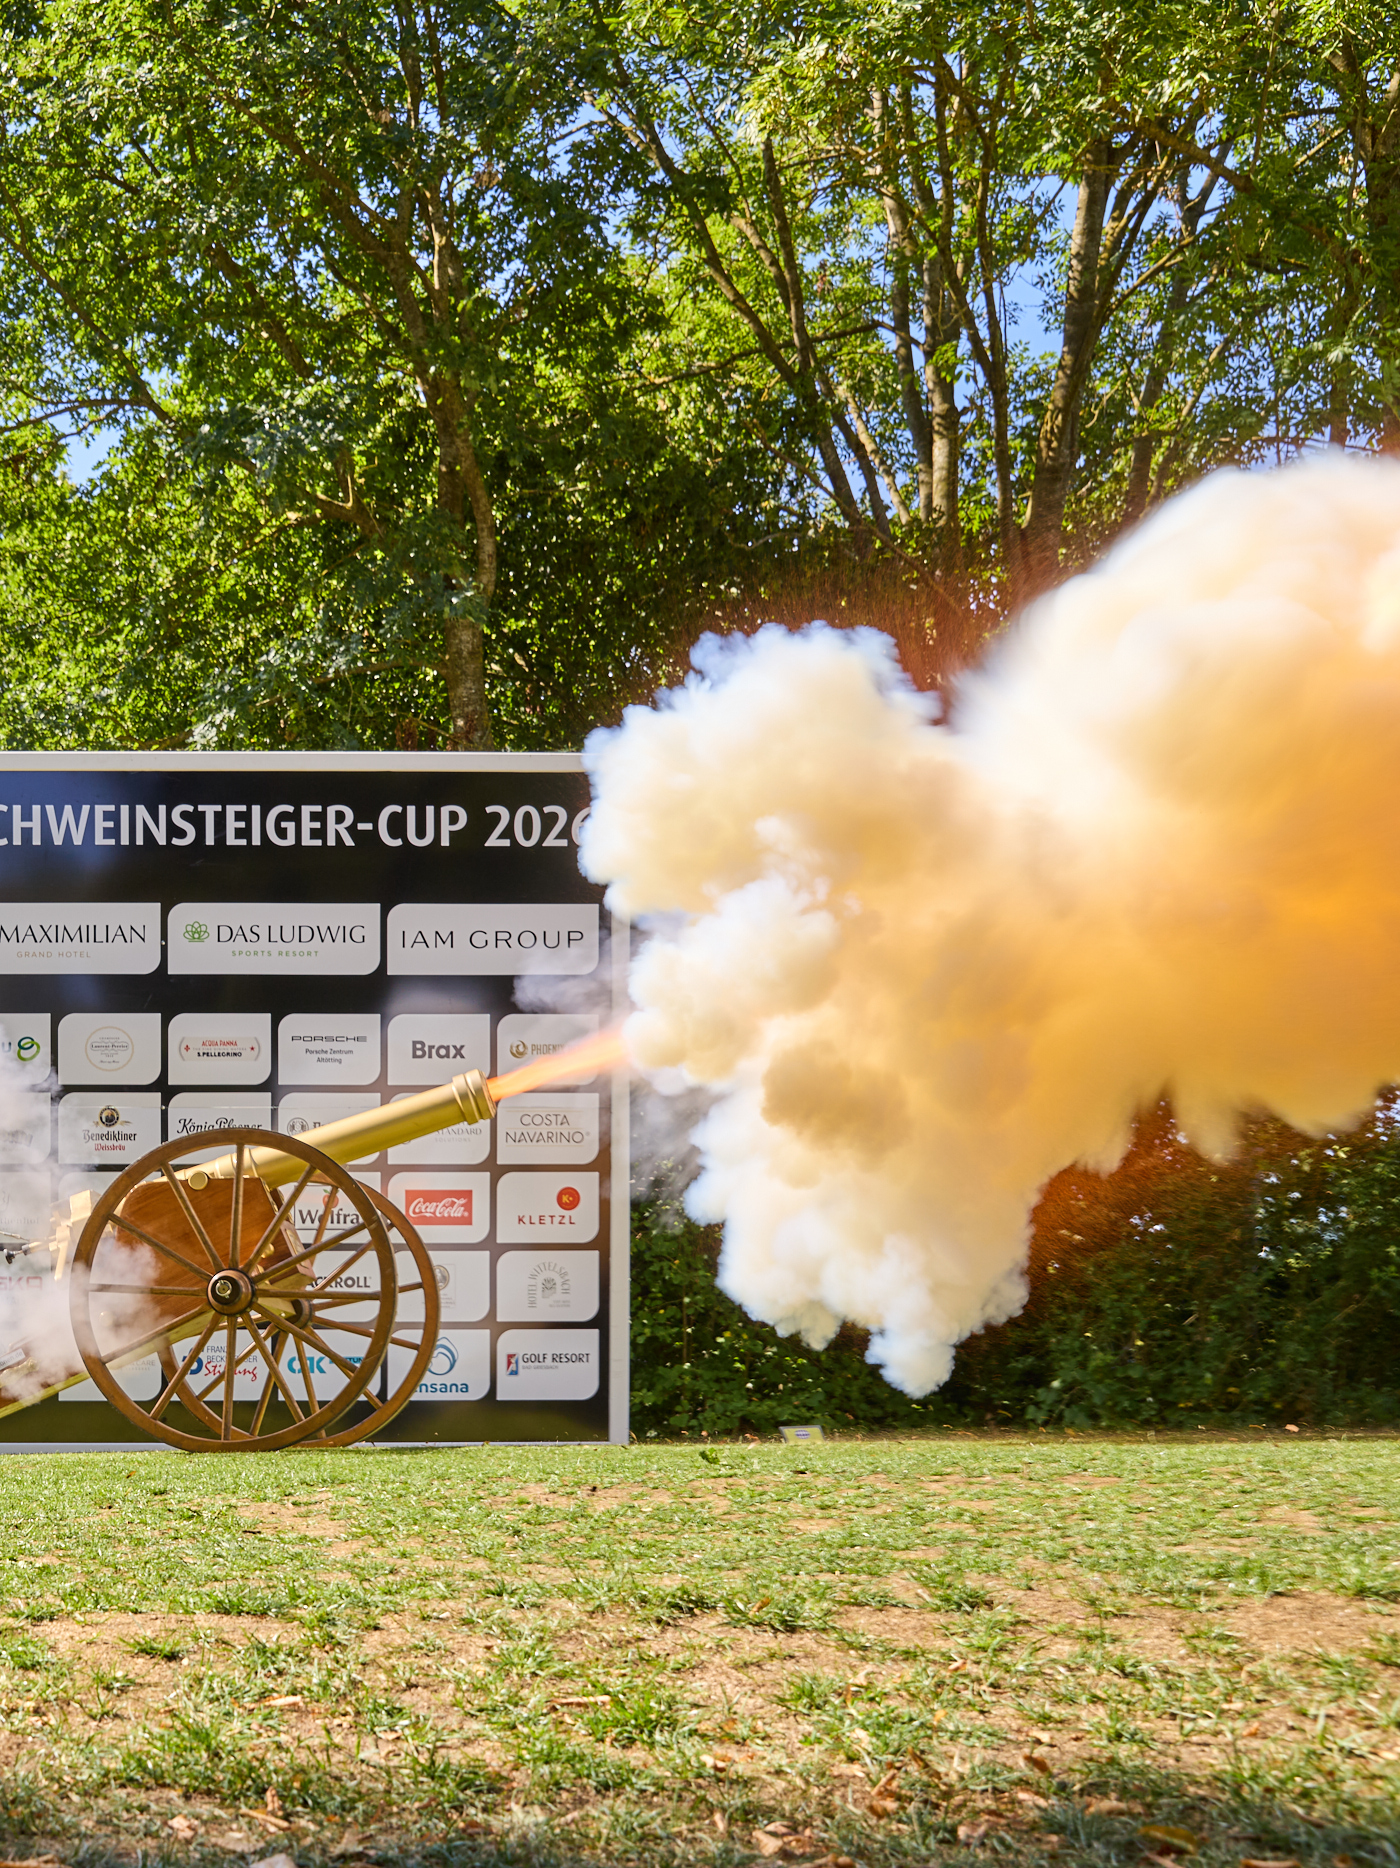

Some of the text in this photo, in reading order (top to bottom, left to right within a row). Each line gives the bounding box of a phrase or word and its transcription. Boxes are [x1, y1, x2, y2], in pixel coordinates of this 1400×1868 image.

[216, 924, 367, 944] DAS LUDWIG
[401, 930, 585, 949] IAM GROUP
[412, 1040, 466, 1059] Brax
[316, 1056, 343, 1064] Altötting
[520, 1113, 570, 1126] COSTA
[82, 1130, 137, 1143] Benediktiner
[505, 1131, 584, 1144] NAVARINO
[517, 1215, 576, 1225] KLETZL
[522, 1353, 590, 1364] GOLF RESORT
[415, 1382, 469, 1393] nsana
